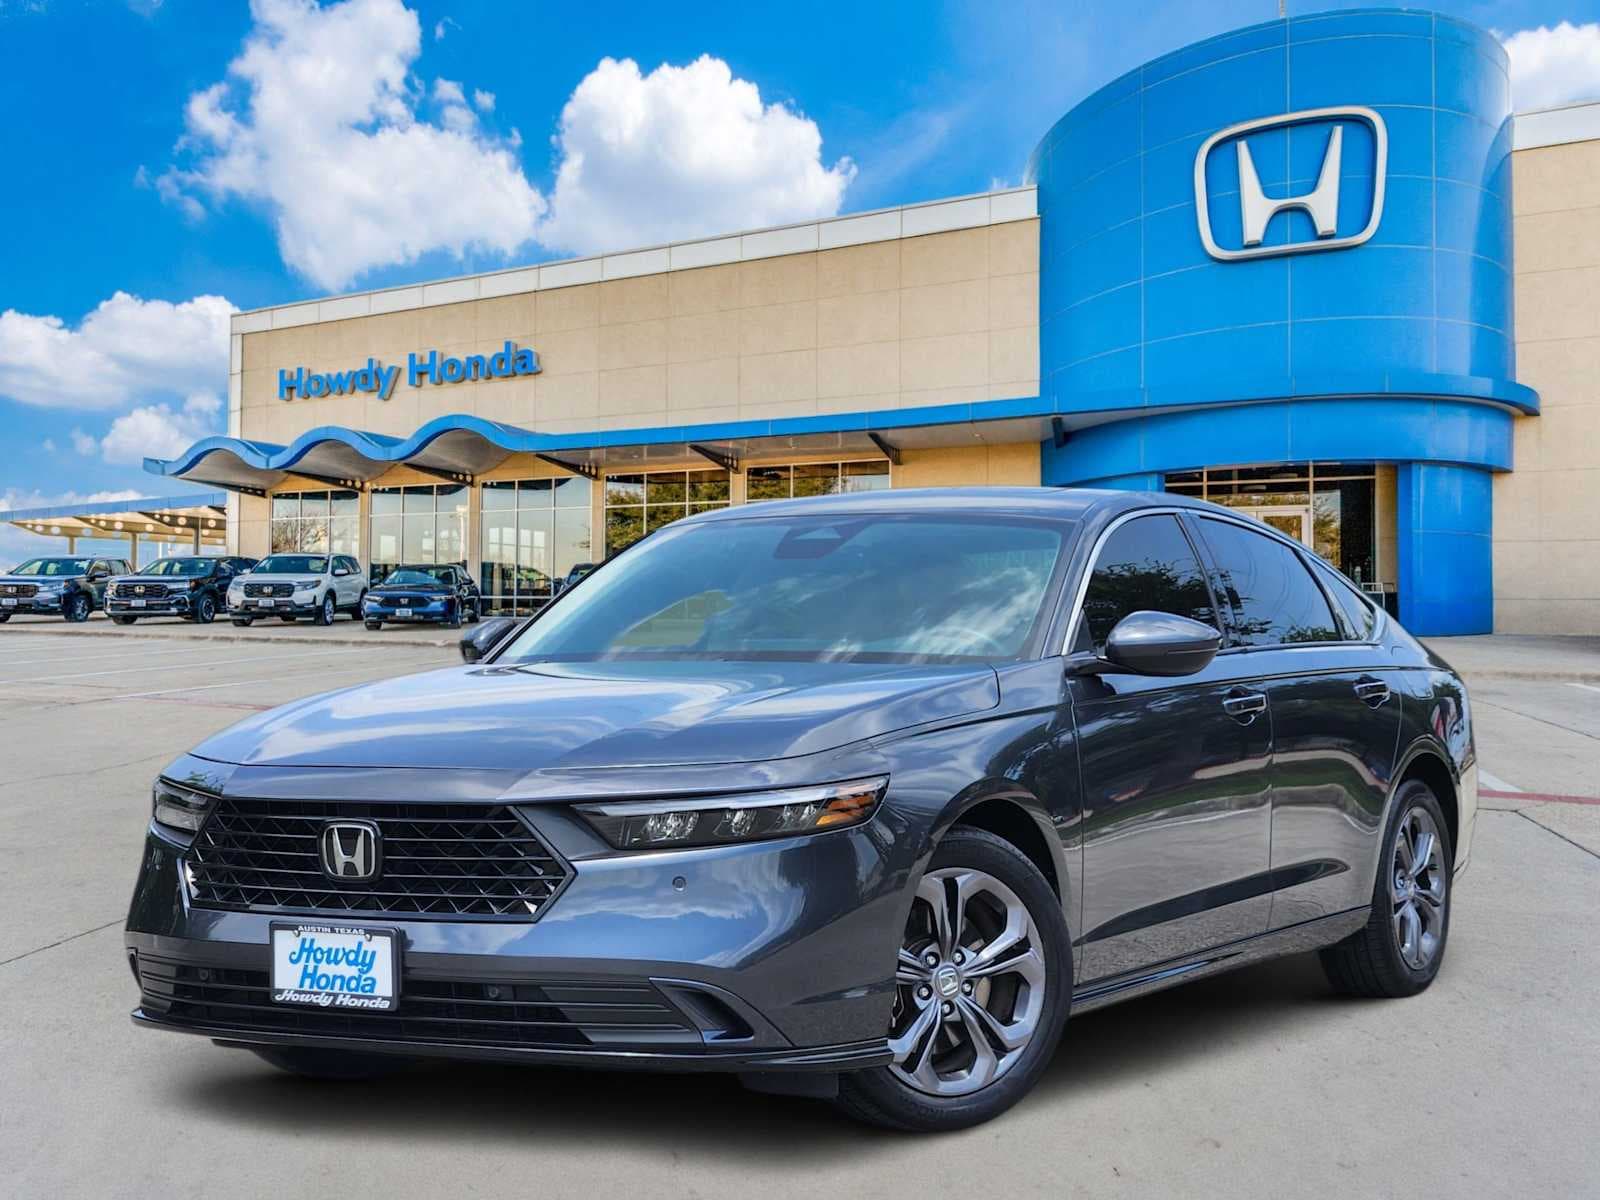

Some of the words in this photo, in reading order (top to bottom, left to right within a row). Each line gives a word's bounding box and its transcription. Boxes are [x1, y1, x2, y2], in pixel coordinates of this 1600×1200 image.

[278, 358, 402, 401] Howdy
[408, 341, 542, 388] Honda
[298, 925, 331, 933] AUSTIN
[335, 927, 365, 935] TEXAS
[289, 937, 377, 974] Howdy
[299, 964, 377, 993] Honda
[275, 990, 334, 1006] Howdy
[335, 994, 390, 1009] Honda
